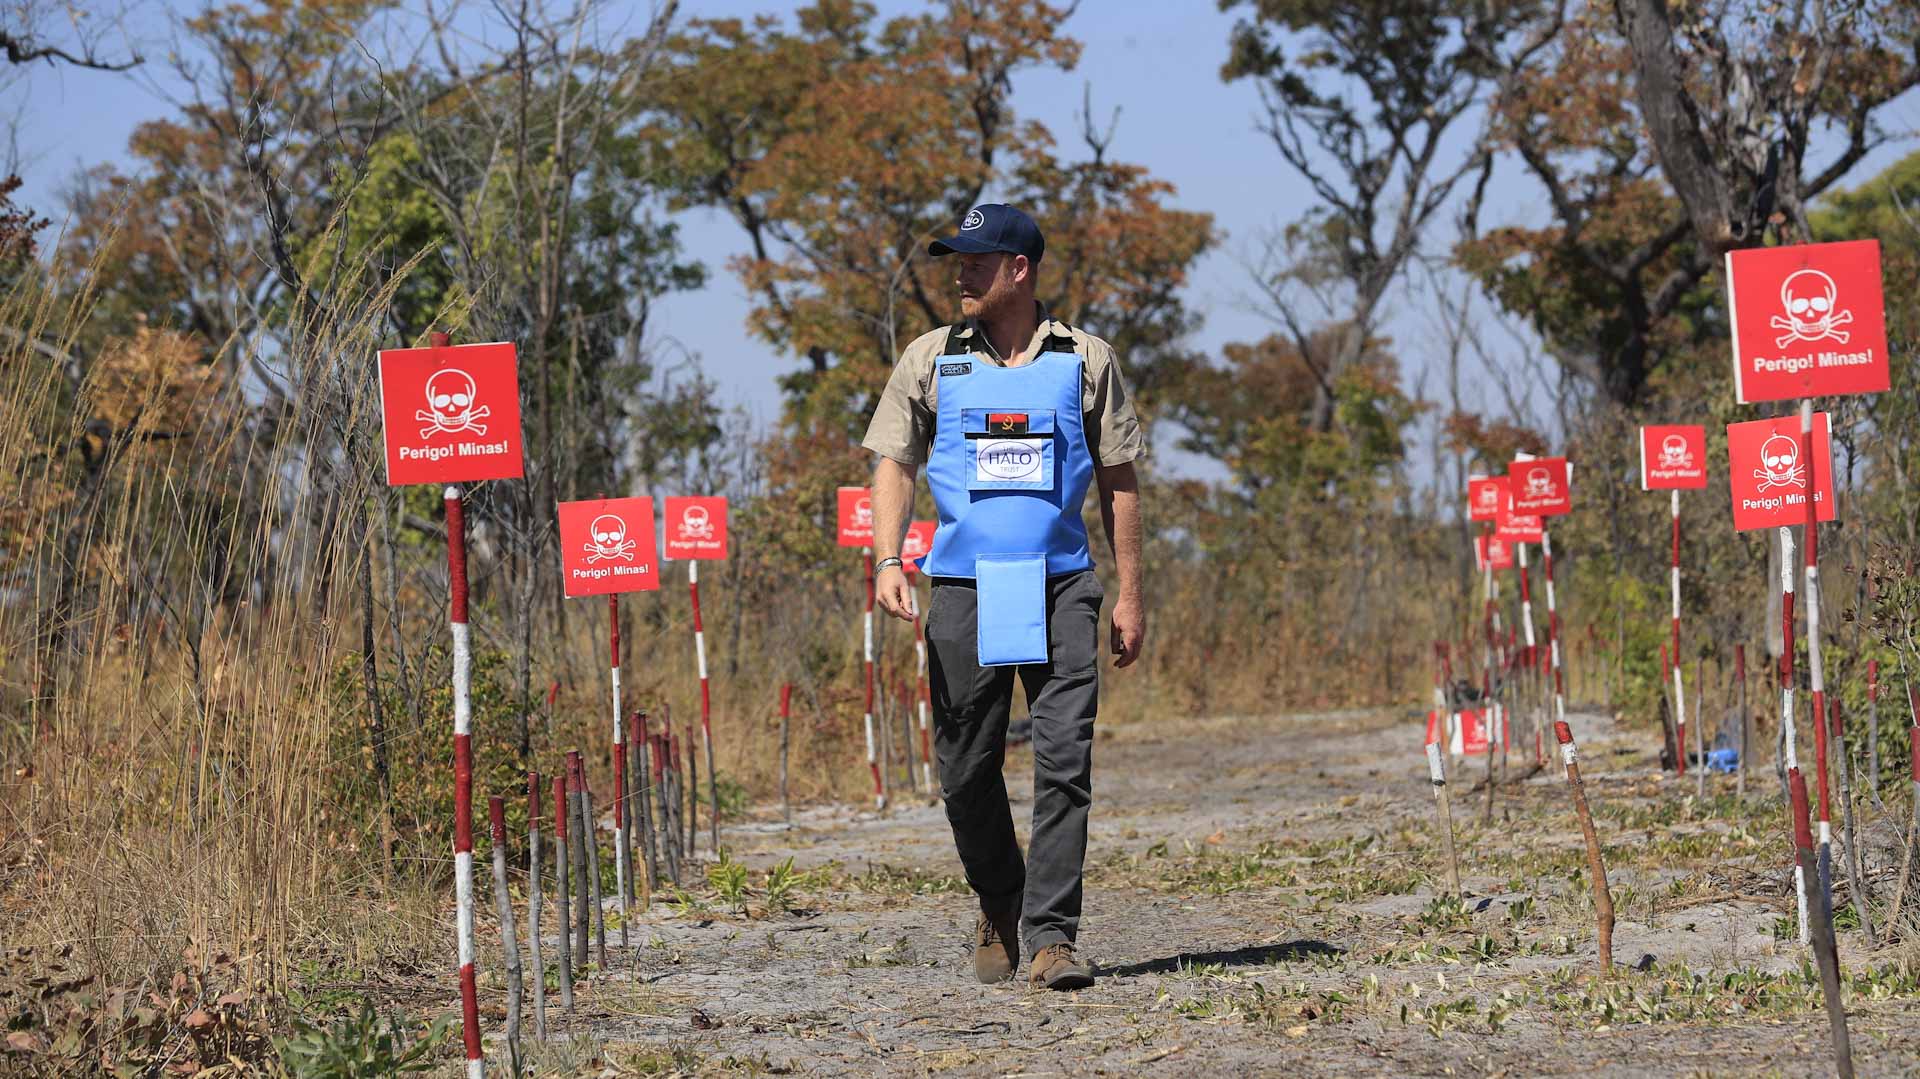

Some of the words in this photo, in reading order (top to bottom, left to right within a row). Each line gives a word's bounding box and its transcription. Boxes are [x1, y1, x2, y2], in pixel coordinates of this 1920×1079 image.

[1754, 354, 1814, 373] Perigo!
[1818, 349, 1873, 367] Minas!
[399, 444, 454, 461] Perigo!
[458, 440, 508, 456] Minas!
[989, 452, 1032, 465] HALO
[1743, 496, 1783, 509] Perigo!
[1786, 491, 1823, 505] Mins!
[573, 567, 611, 579] Perigo!
[614, 563, 649, 575] Minas!
